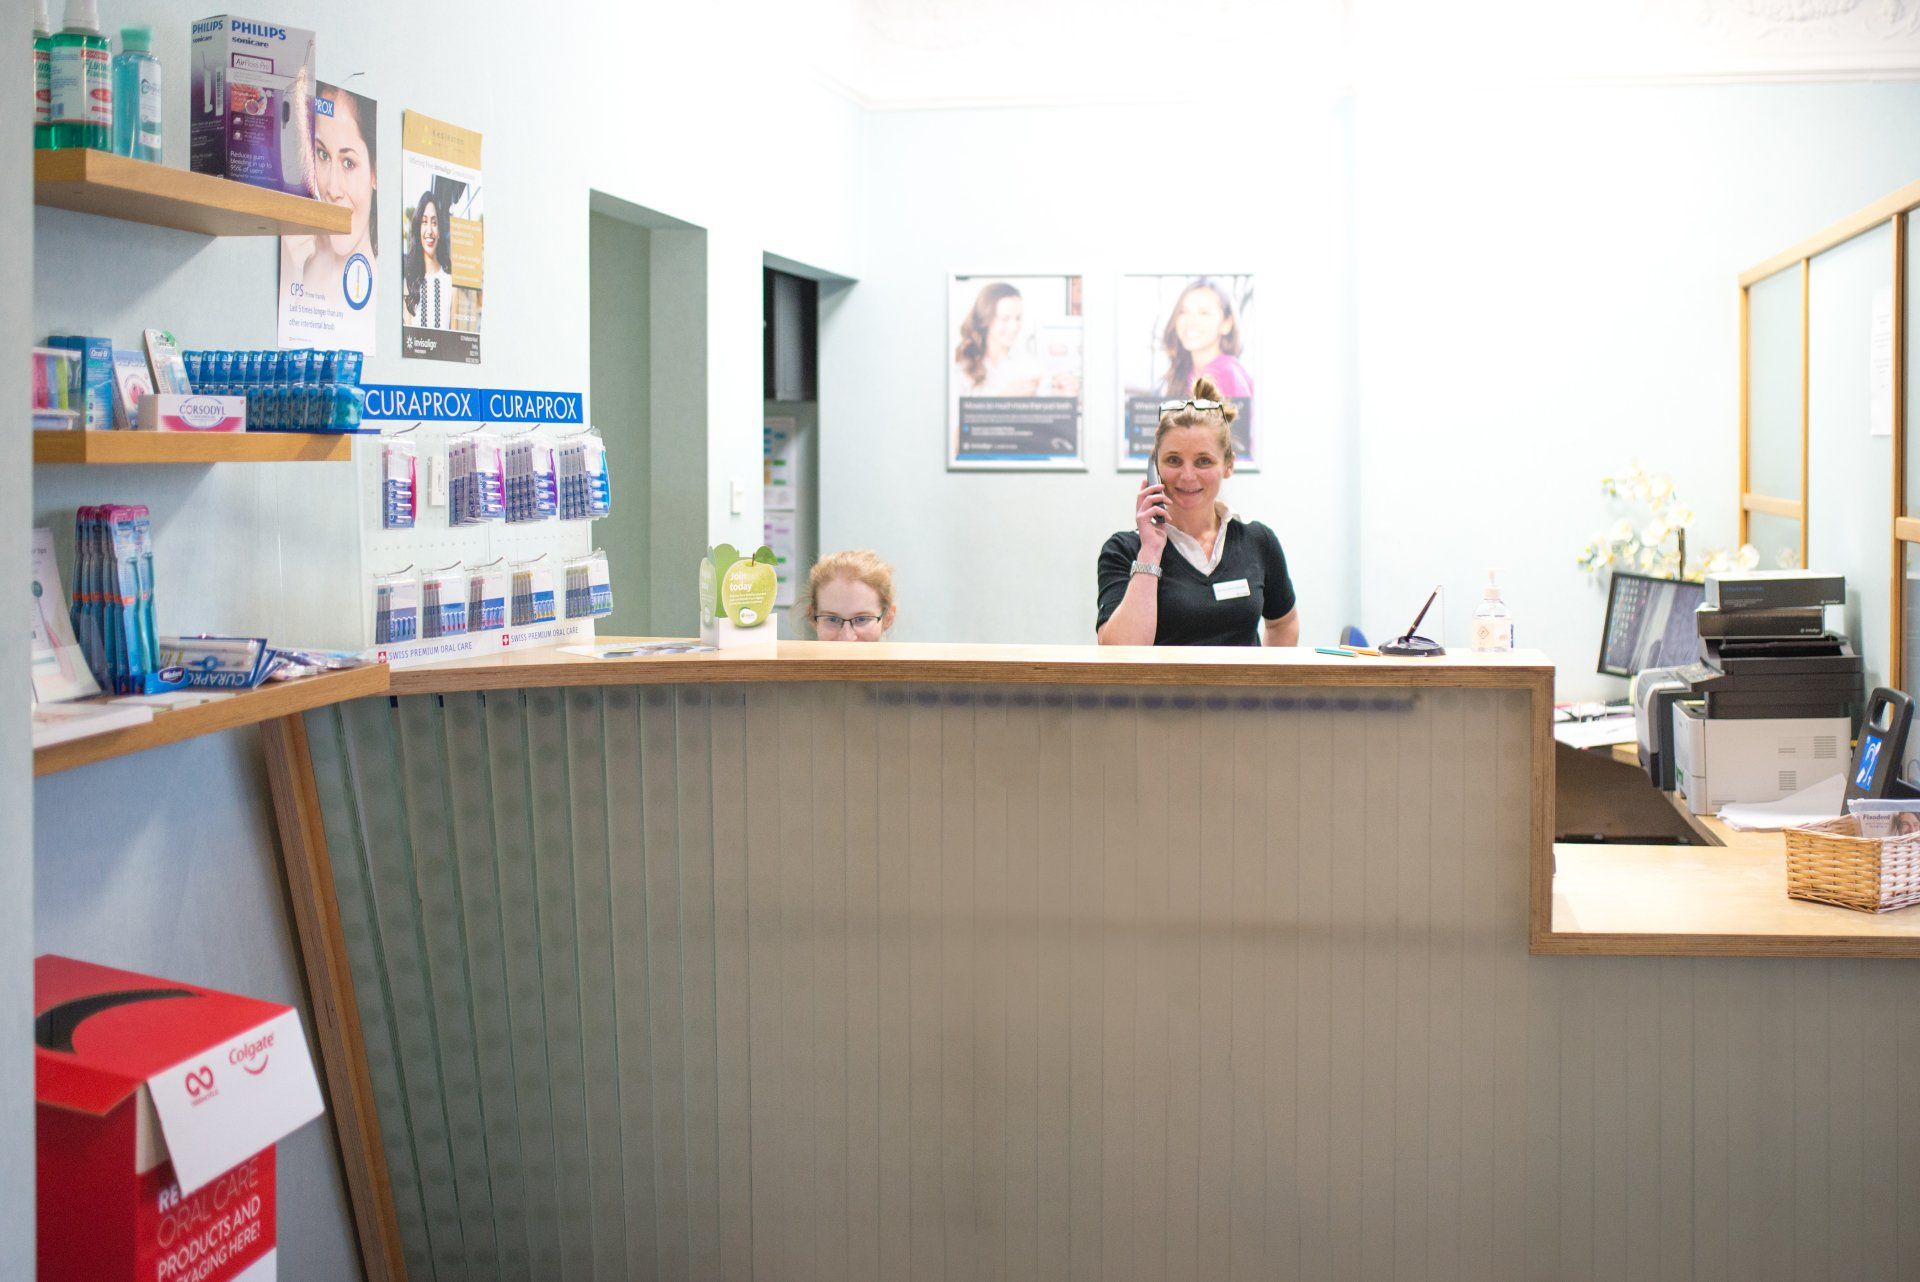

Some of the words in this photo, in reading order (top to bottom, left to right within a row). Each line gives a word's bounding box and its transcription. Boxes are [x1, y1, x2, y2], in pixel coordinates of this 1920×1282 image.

[192, 20, 223, 34] PHILIPS
[231, 20, 286, 40] PHILIPS
[231, 36, 269, 48] sonicare
[230, 150, 252, 160] Reduces
[290, 282, 304, 297] CPS
[289, 303, 298, 312] Last
[179, 404, 226, 416] CORSODYL
[365, 389, 472, 417] CURAPROX
[489, 394, 577, 420] CURAPROX
[730, 572, 745, 581] Join
[729, 582, 753, 593] today
[510, 633, 527, 643] SWISS
[528, 630, 552, 640] PREMIUM
[552, 628, 566, 637] ORAL
[566, 626, 579, 635] CARE
[388, 650, 409, 661] SWISS
[410, 646, 439, 657] PREMIUM
[440, 644, 456, 653] ORAL
[457, 641, 472, 650] CARE
[188, 672, 246, 686] CURAPRO
[228, 1033, 274, 1065] Colgate
[158, 1193, 211, 1249] ORAL
[213, 1156, 260, 1210] CARE
[158, 1215, 231, 1282] PRODUCTS
[232, 1194, 261, 1231] AND
[229, 1220, 261, 1258] HERE!
